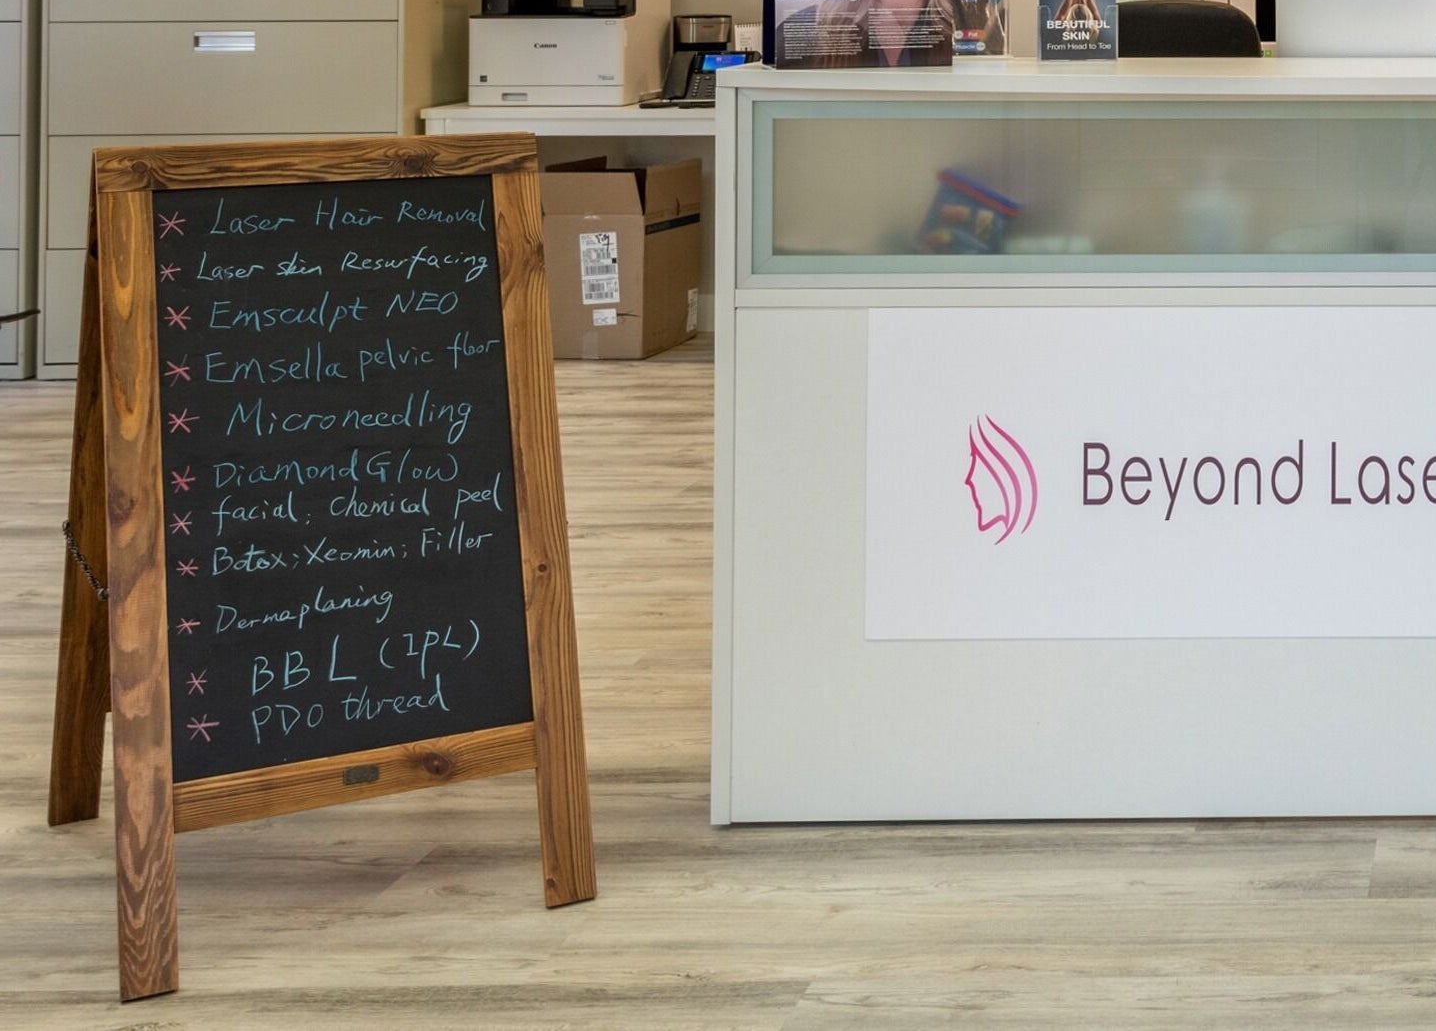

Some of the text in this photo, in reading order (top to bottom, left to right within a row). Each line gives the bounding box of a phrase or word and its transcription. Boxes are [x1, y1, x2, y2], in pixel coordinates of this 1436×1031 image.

[1046, 20, 1111, 29] BEAUTIFUL
[1062, 31, 1090, 41] SKIN
[1047, 43, 1066, 51] From
[1067, 43, 1087, 51] Head
[210, 197, 487, 234] Laser Hair Removal
[197, 251, 264, 282] Laser
[341, 246, 488, 282] Resurfacing
[209, 290, 459, 332] Emsculpt NEO
[206, 342, 348, 383] Emsella
[359, 338, 434, 382] pelvic
[454, 472, 503, 520] peel
[1082, 439, 1305, 521] Beyond
[421, 521, 493, 557] Filler
[216, 585, 393, 634] Dermaplaning
[251, 634, 357, 697] BBL
[251, 673, 450, 745] PDO thread
